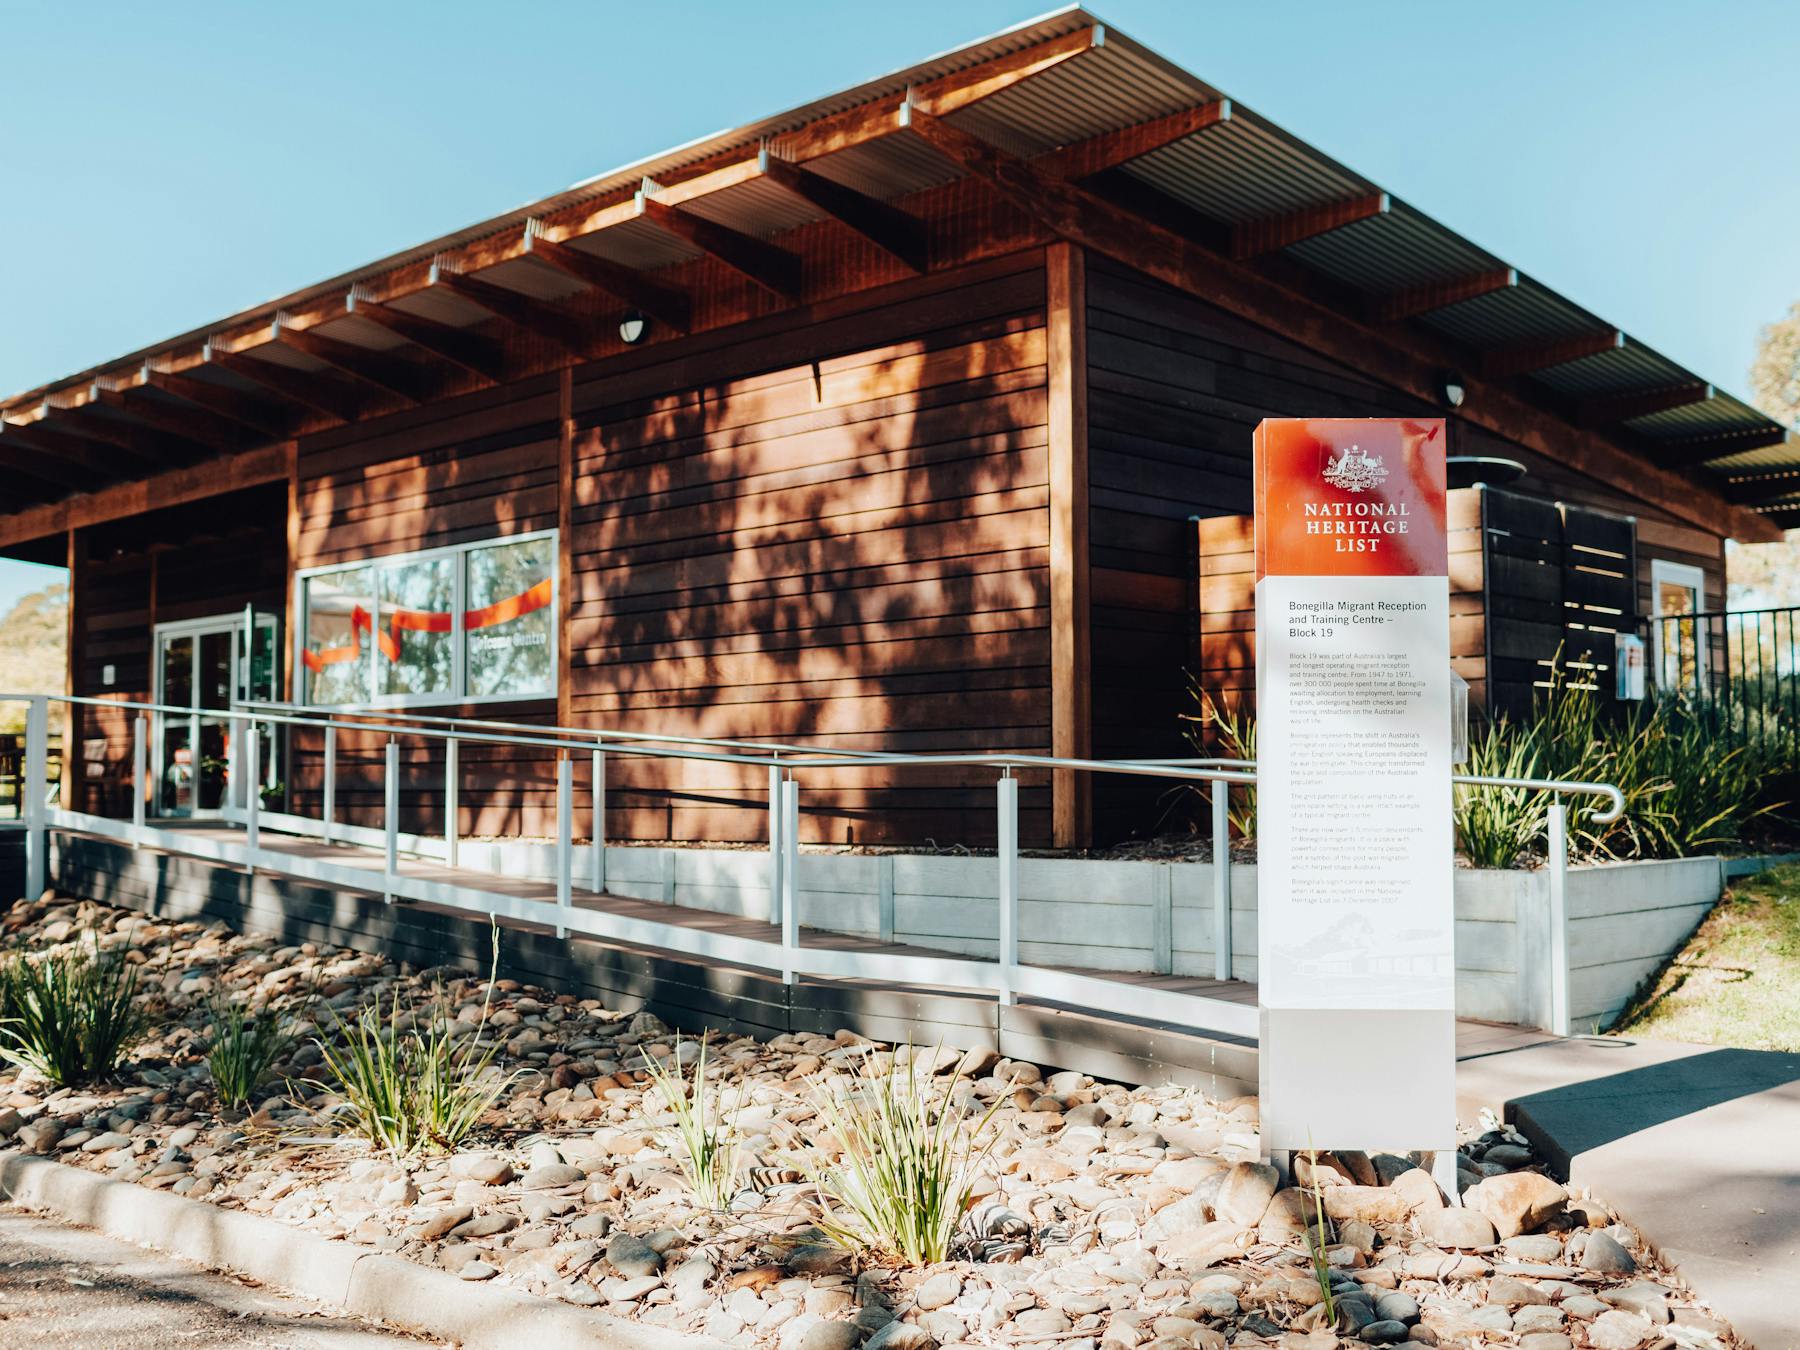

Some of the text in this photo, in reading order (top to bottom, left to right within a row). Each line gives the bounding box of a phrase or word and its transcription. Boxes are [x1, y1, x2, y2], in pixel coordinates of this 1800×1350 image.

[1304, 503, 1410, 517] NATIONAL
[1306, 521, 1409, 535] HERITAGE
[1335, 539, 1380, 552] LIST
[1289, 601, 1427, 613] Bonegilla Migrant Reception
[1289, 615, 1307, 625] and
[1311, 615, 1350, 626] Training
[1352, 615, 1384, 625] Centre
[1289, 628, 1333, 638] Block 19
